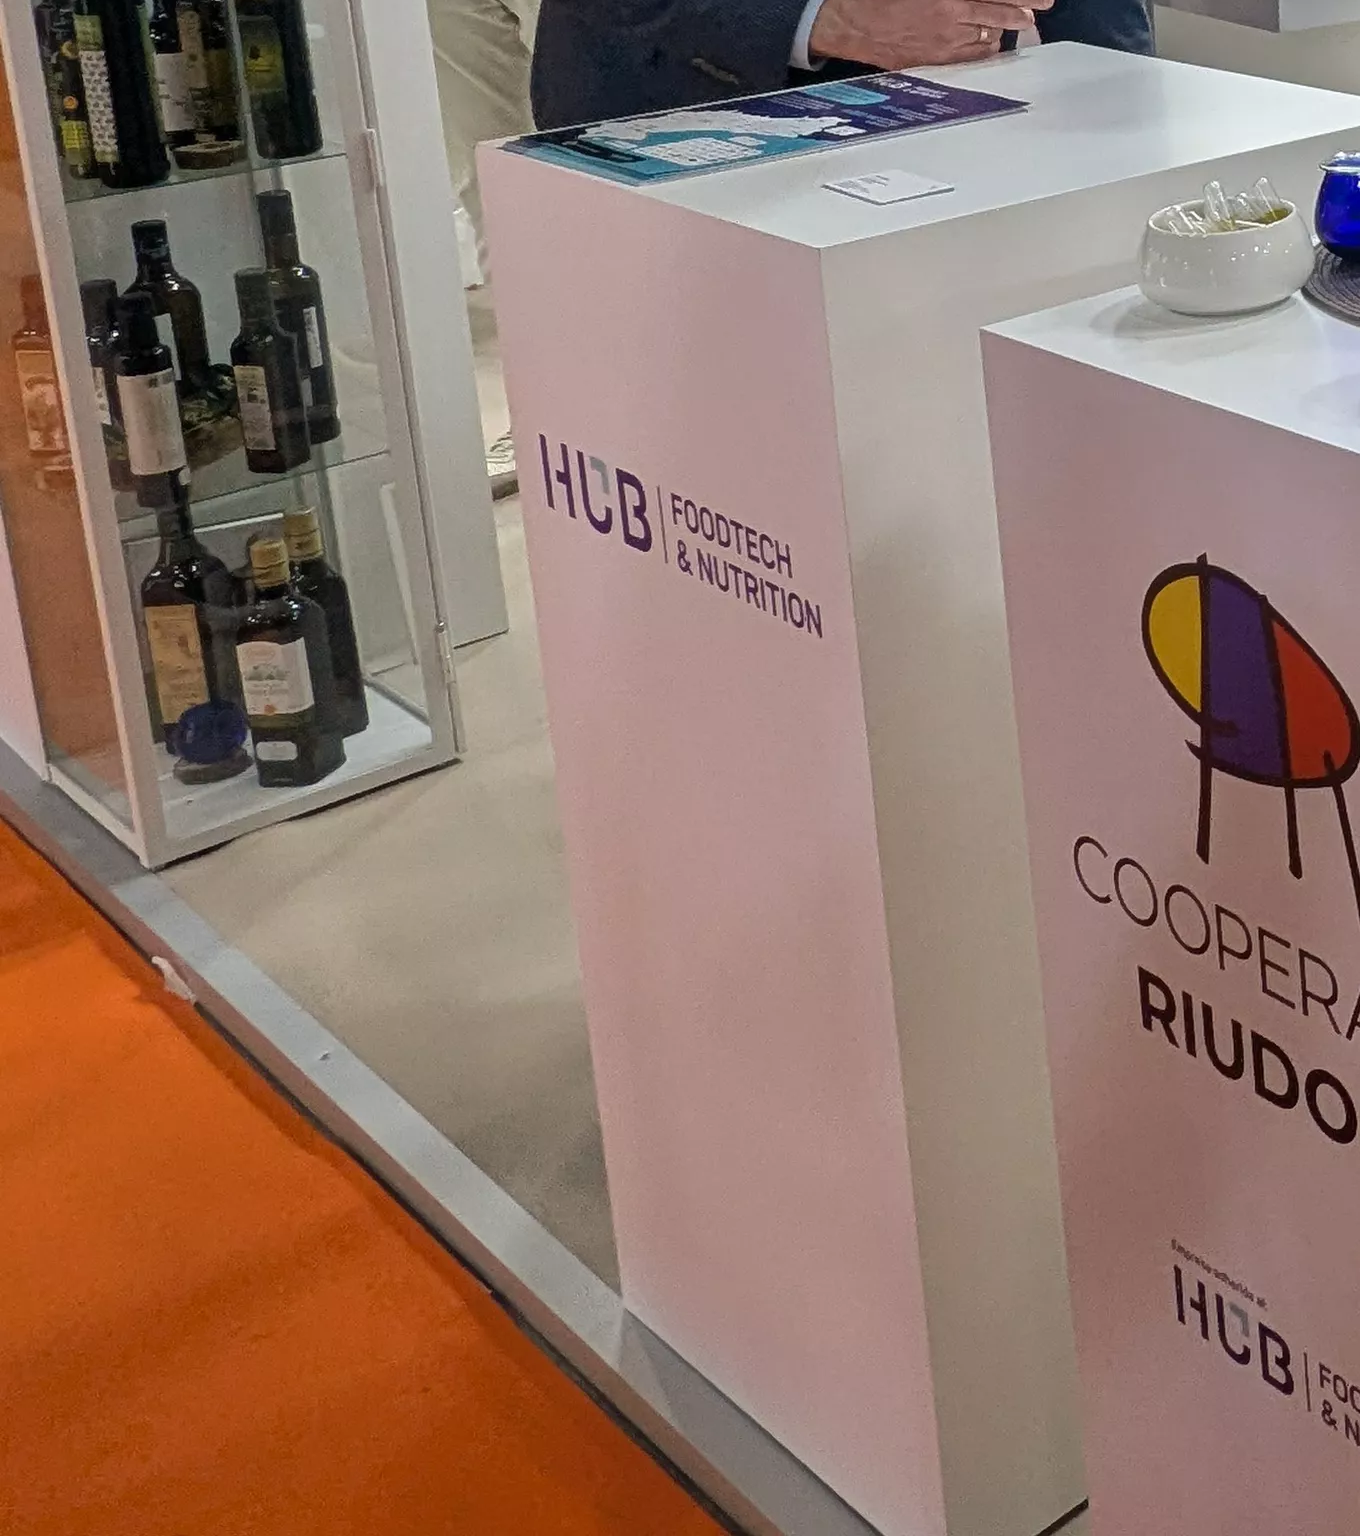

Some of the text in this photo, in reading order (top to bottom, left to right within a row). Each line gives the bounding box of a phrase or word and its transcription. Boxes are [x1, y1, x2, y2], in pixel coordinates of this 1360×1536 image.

[538, 432, 653, 553] HUB
[670, 491, 792, 579] FOODTECH
[676, 537, 823, 640] & NUTRITION
[1173, 1263, 1295, 1396] HUB
[1320, 1398, 1339, 1431] &
